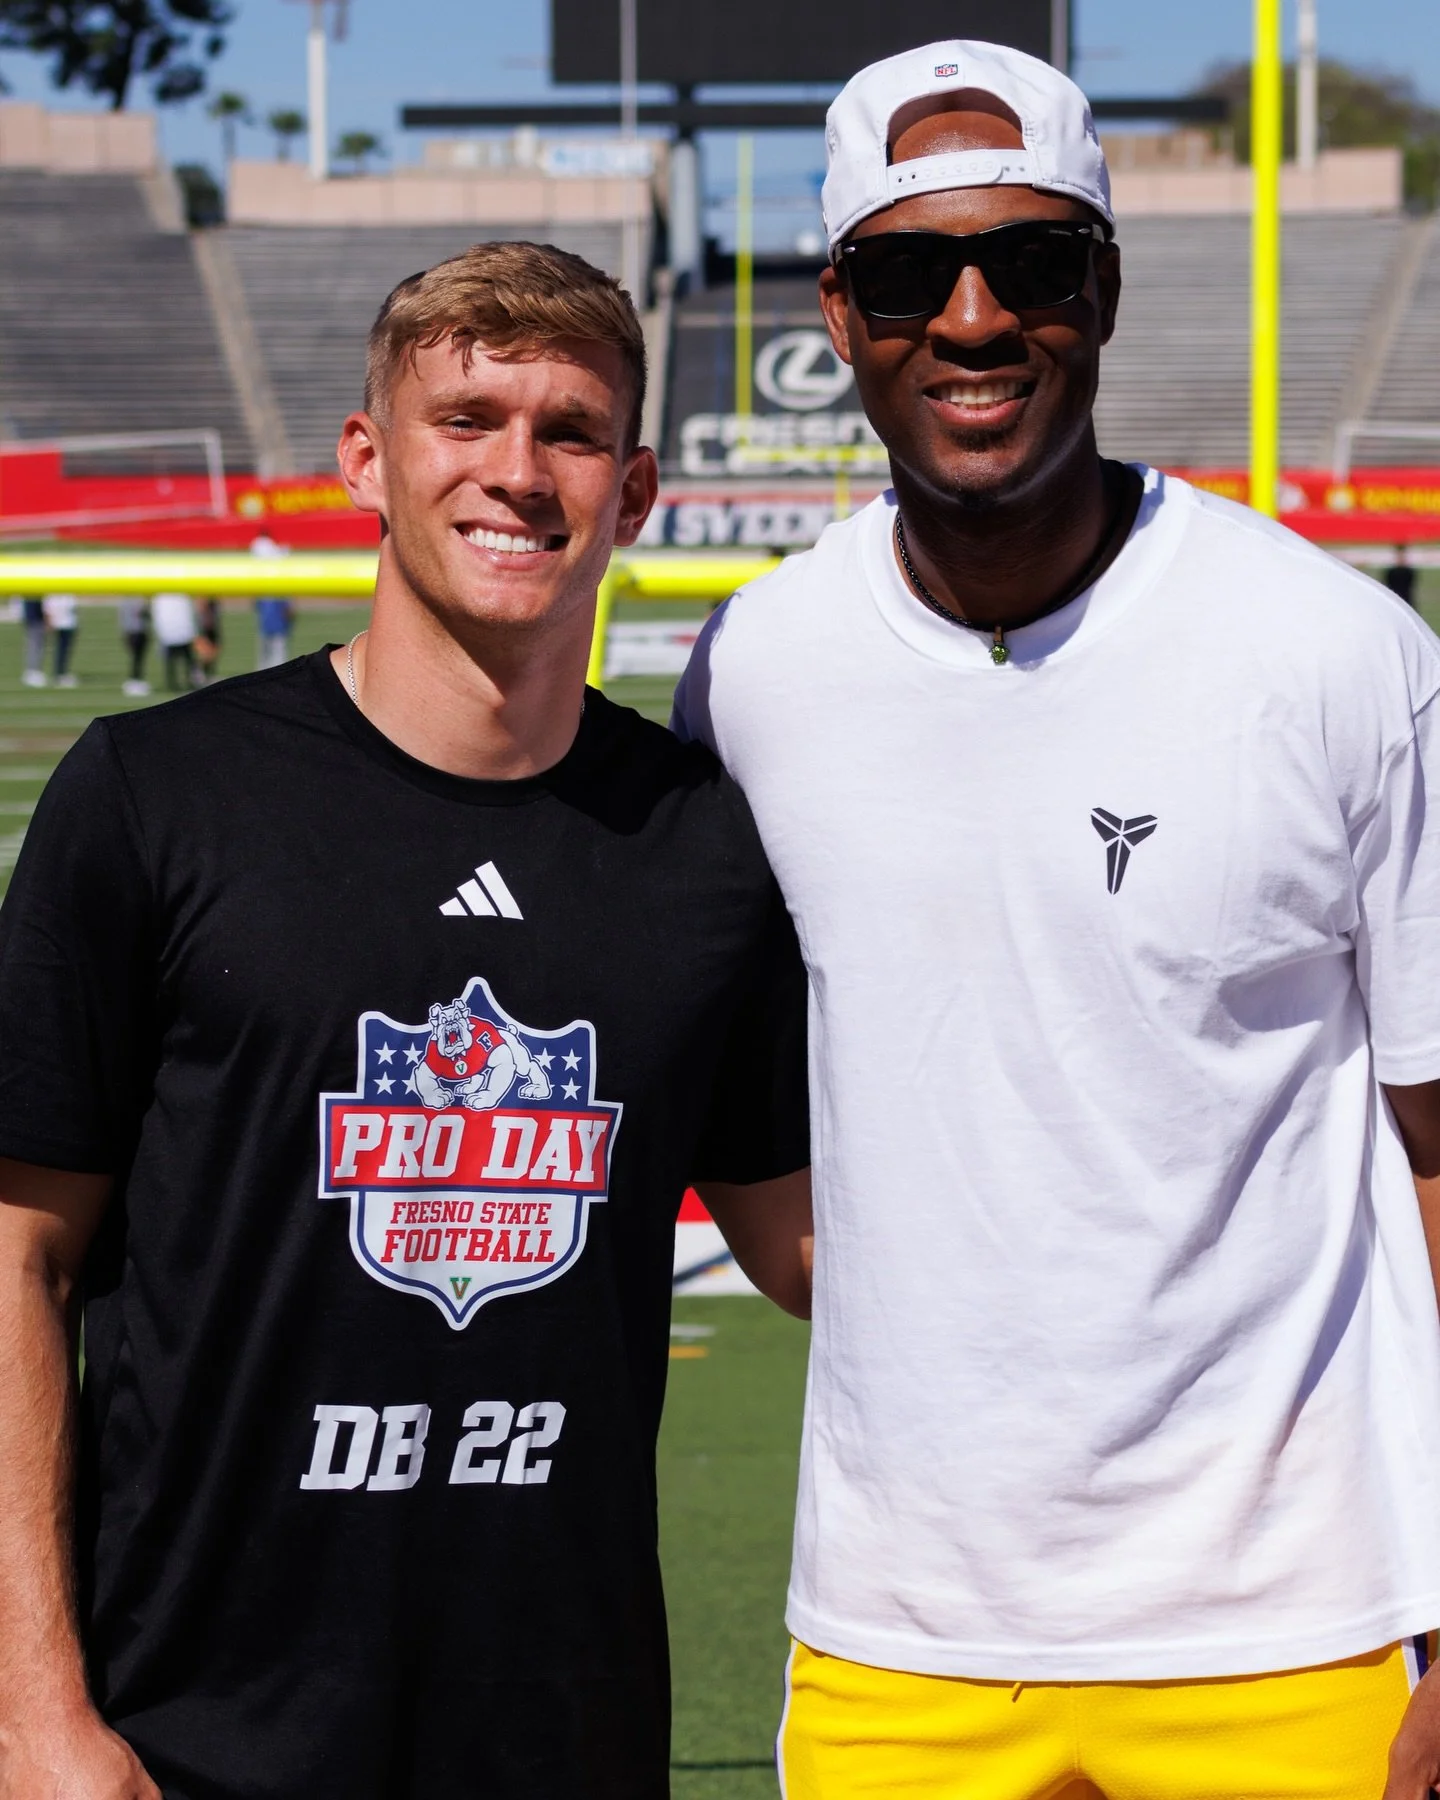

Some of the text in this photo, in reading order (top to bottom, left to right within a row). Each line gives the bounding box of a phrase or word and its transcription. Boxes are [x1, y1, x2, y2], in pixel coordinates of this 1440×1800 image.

[476, 1031, 493, 1052] F
[456, 1063, 465, 1074] V
[333, 1112, 609, 1183] PRO DAY
[390, 1200, 552, 1225] FRESNO STATE
[380, 1229, 556, 1263] FOOTBALL
[450, 1277, 472, 1300] V
[300, 1401, 567, 1491] DB 22
